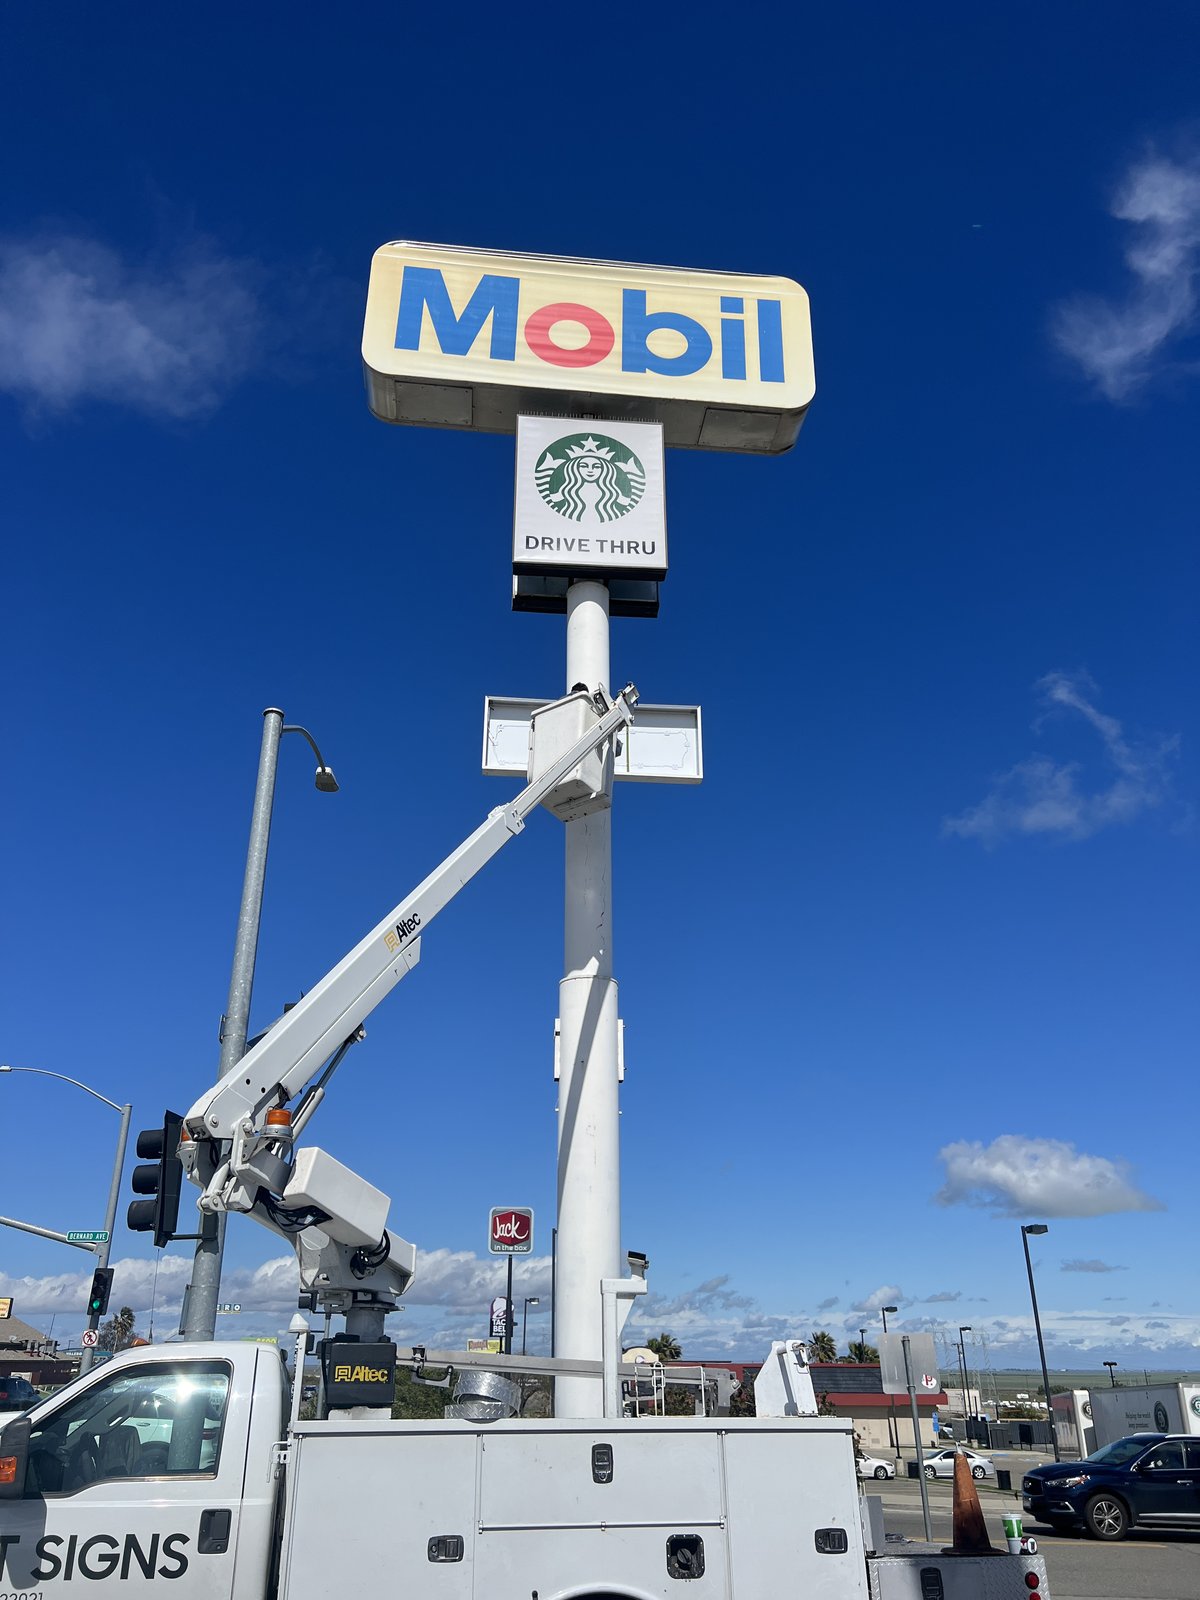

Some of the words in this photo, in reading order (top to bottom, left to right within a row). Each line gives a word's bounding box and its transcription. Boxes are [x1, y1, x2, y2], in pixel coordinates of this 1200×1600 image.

[394, 266, 785, 383] Mobil
[525, 535, 590, 552] DRIVE
[595, 539, 656, 555] THRU
[395, 912, 421, 943] Altec
[69, 1232, 93, 1240] BERNARD
[95, 1232, 106, 1240] AVE
[493, 1214, 529, 1239] Jack
[351, 1365, 389, 1382] Altec
[30, 1533, 191, 1581] SIGNS
